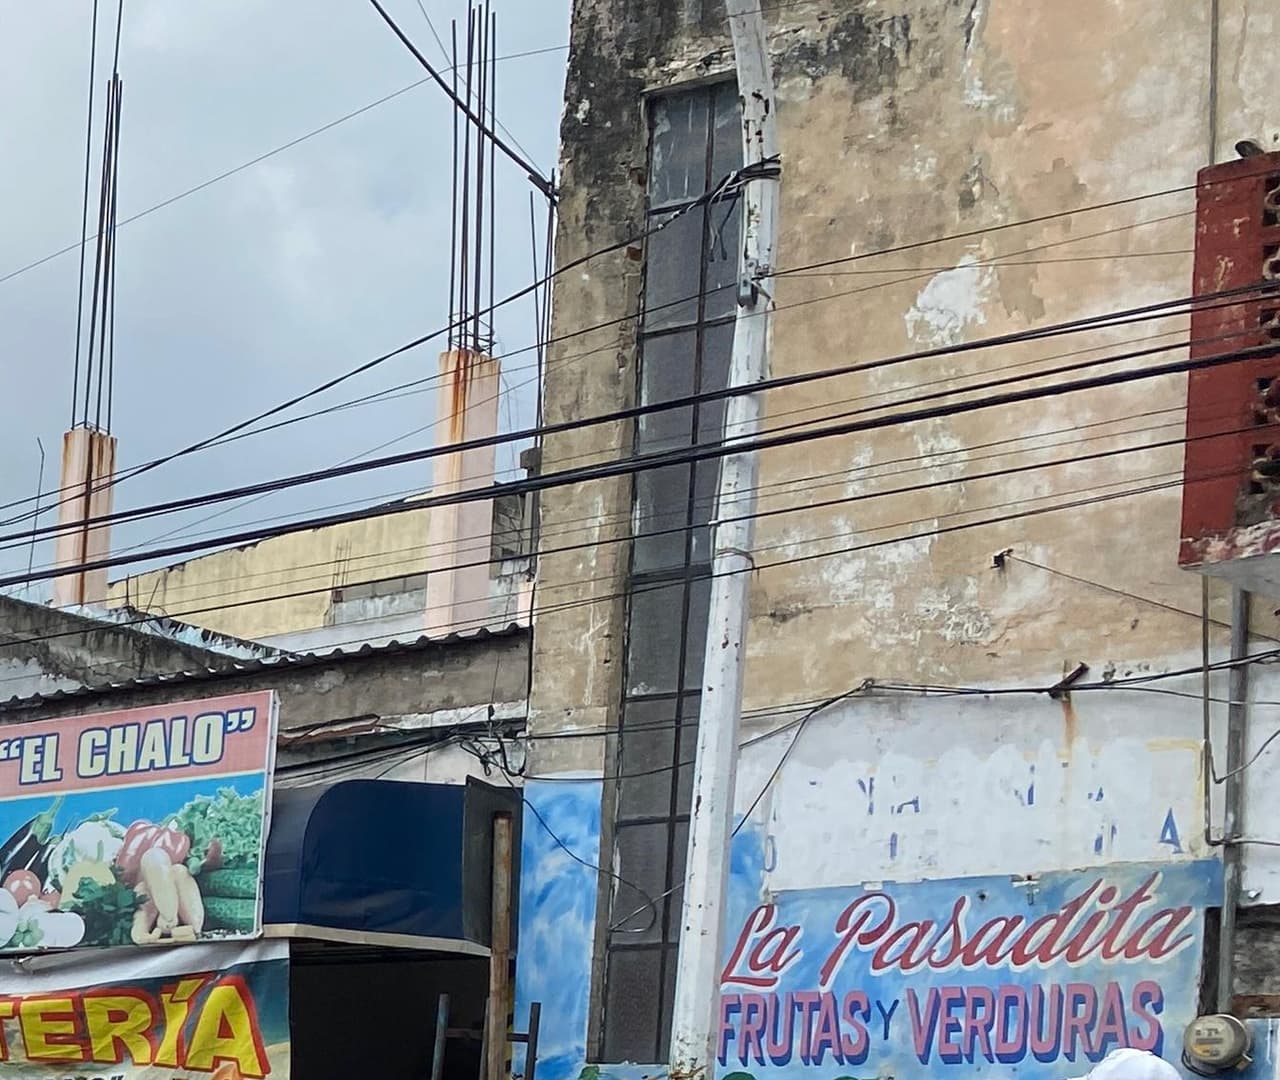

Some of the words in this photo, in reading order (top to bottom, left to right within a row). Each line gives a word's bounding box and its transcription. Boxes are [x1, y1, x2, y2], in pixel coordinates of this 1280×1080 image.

[721, 901, 803, 988] La
[817, 871, 1197, 990] Pasadita
[717, 988, 872, 1068] FRUTAS
[871, 998, 900, 1040] Y
[906, 980, 1165, 1067] VERDURAS
